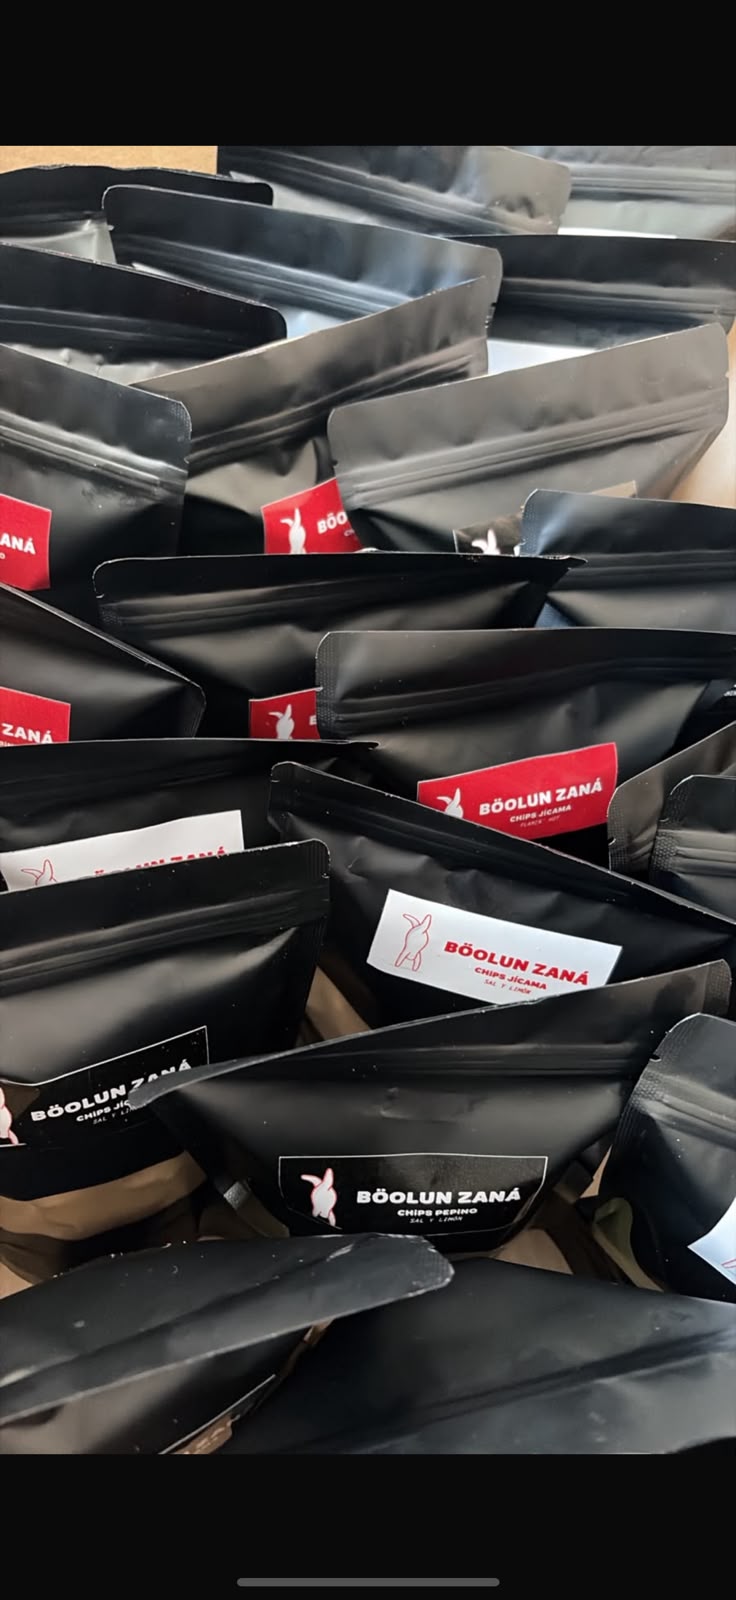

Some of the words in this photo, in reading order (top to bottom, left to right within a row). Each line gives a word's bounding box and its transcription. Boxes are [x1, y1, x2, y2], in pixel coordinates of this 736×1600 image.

[317, 511, 349, 535] BÖO
[0, 532, 36, 555] ANÁ
[1, 722, 54, 744] ZANÁ
[479, 790, 552, 816] BÖOLUN
[555, 777, 603, 802] ZANÁ
[444, 941, 529, 972] BÖOLUN
[532, 963, 590, 986] ZANÁ
[30, 1084, 127, 1122] BÖOLUN
[356, 1188, 453, 1205] BÖOLUN
[457, 1187, 521, 1204] ZANÁ
